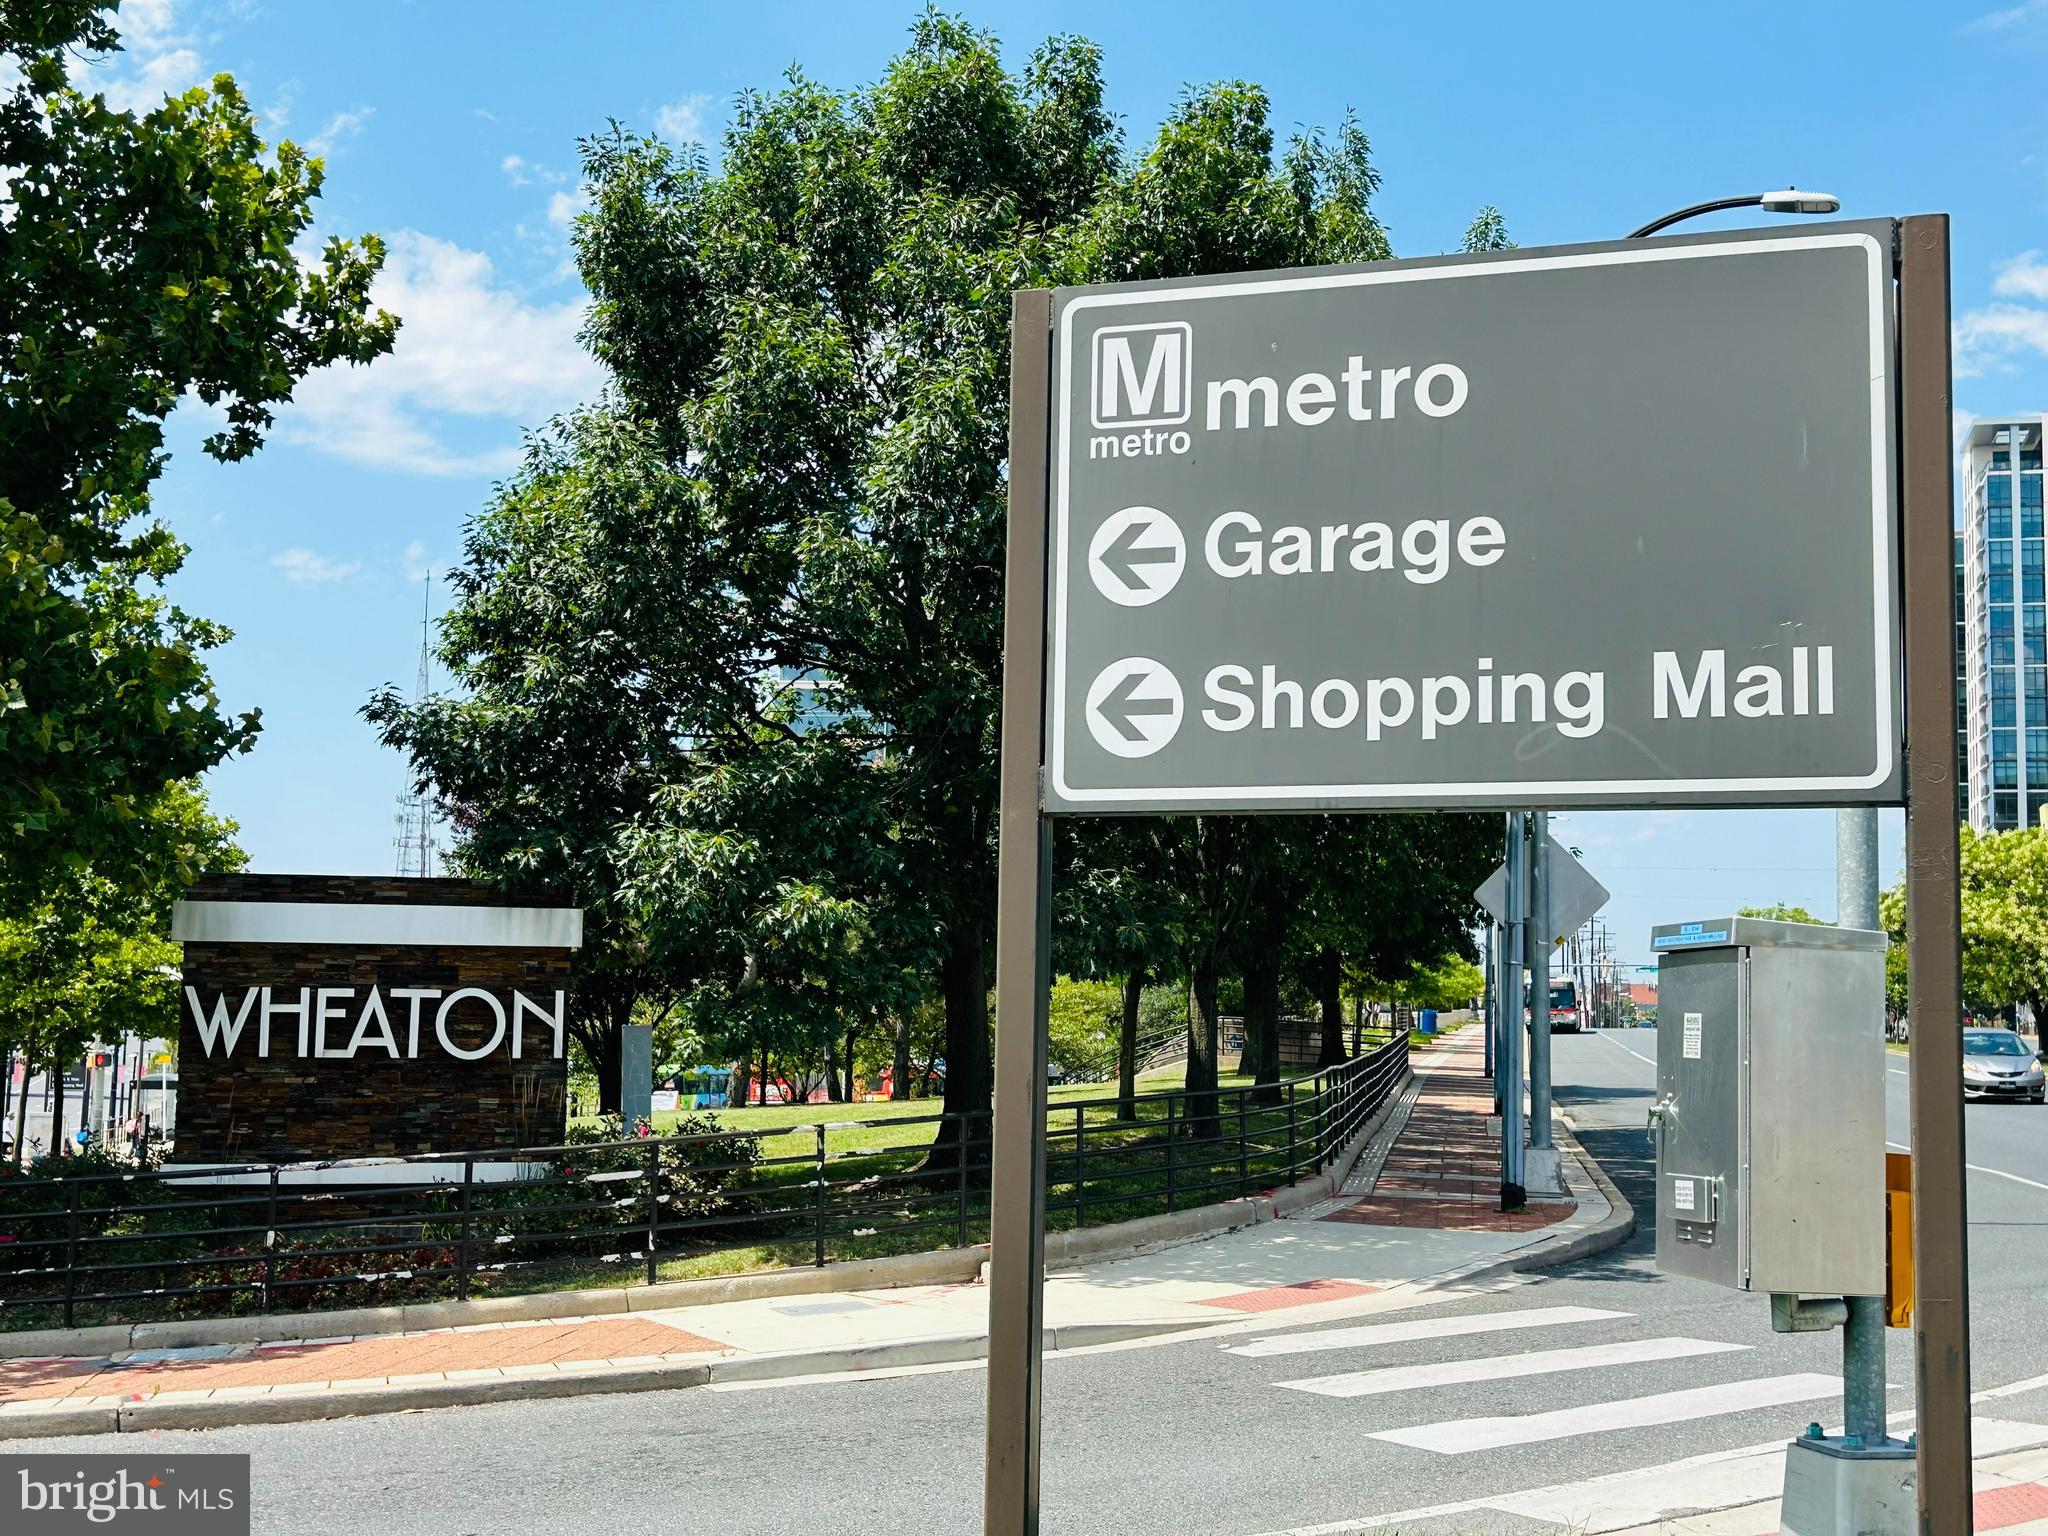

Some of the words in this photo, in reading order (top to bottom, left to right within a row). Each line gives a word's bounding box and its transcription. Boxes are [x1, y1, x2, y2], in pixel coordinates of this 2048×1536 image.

[1101, 332, 1182, 418] M
[1206, 355, 1469, 431] metro
[1089, 427, 1192, 459] metro
[1204, 511, 1507, 585] Garage
[1201, 657, 1605, 741] Shopping
[1652, 645, 1835, 719] Mall
[184, 984, 565, 1060] WHEATON
